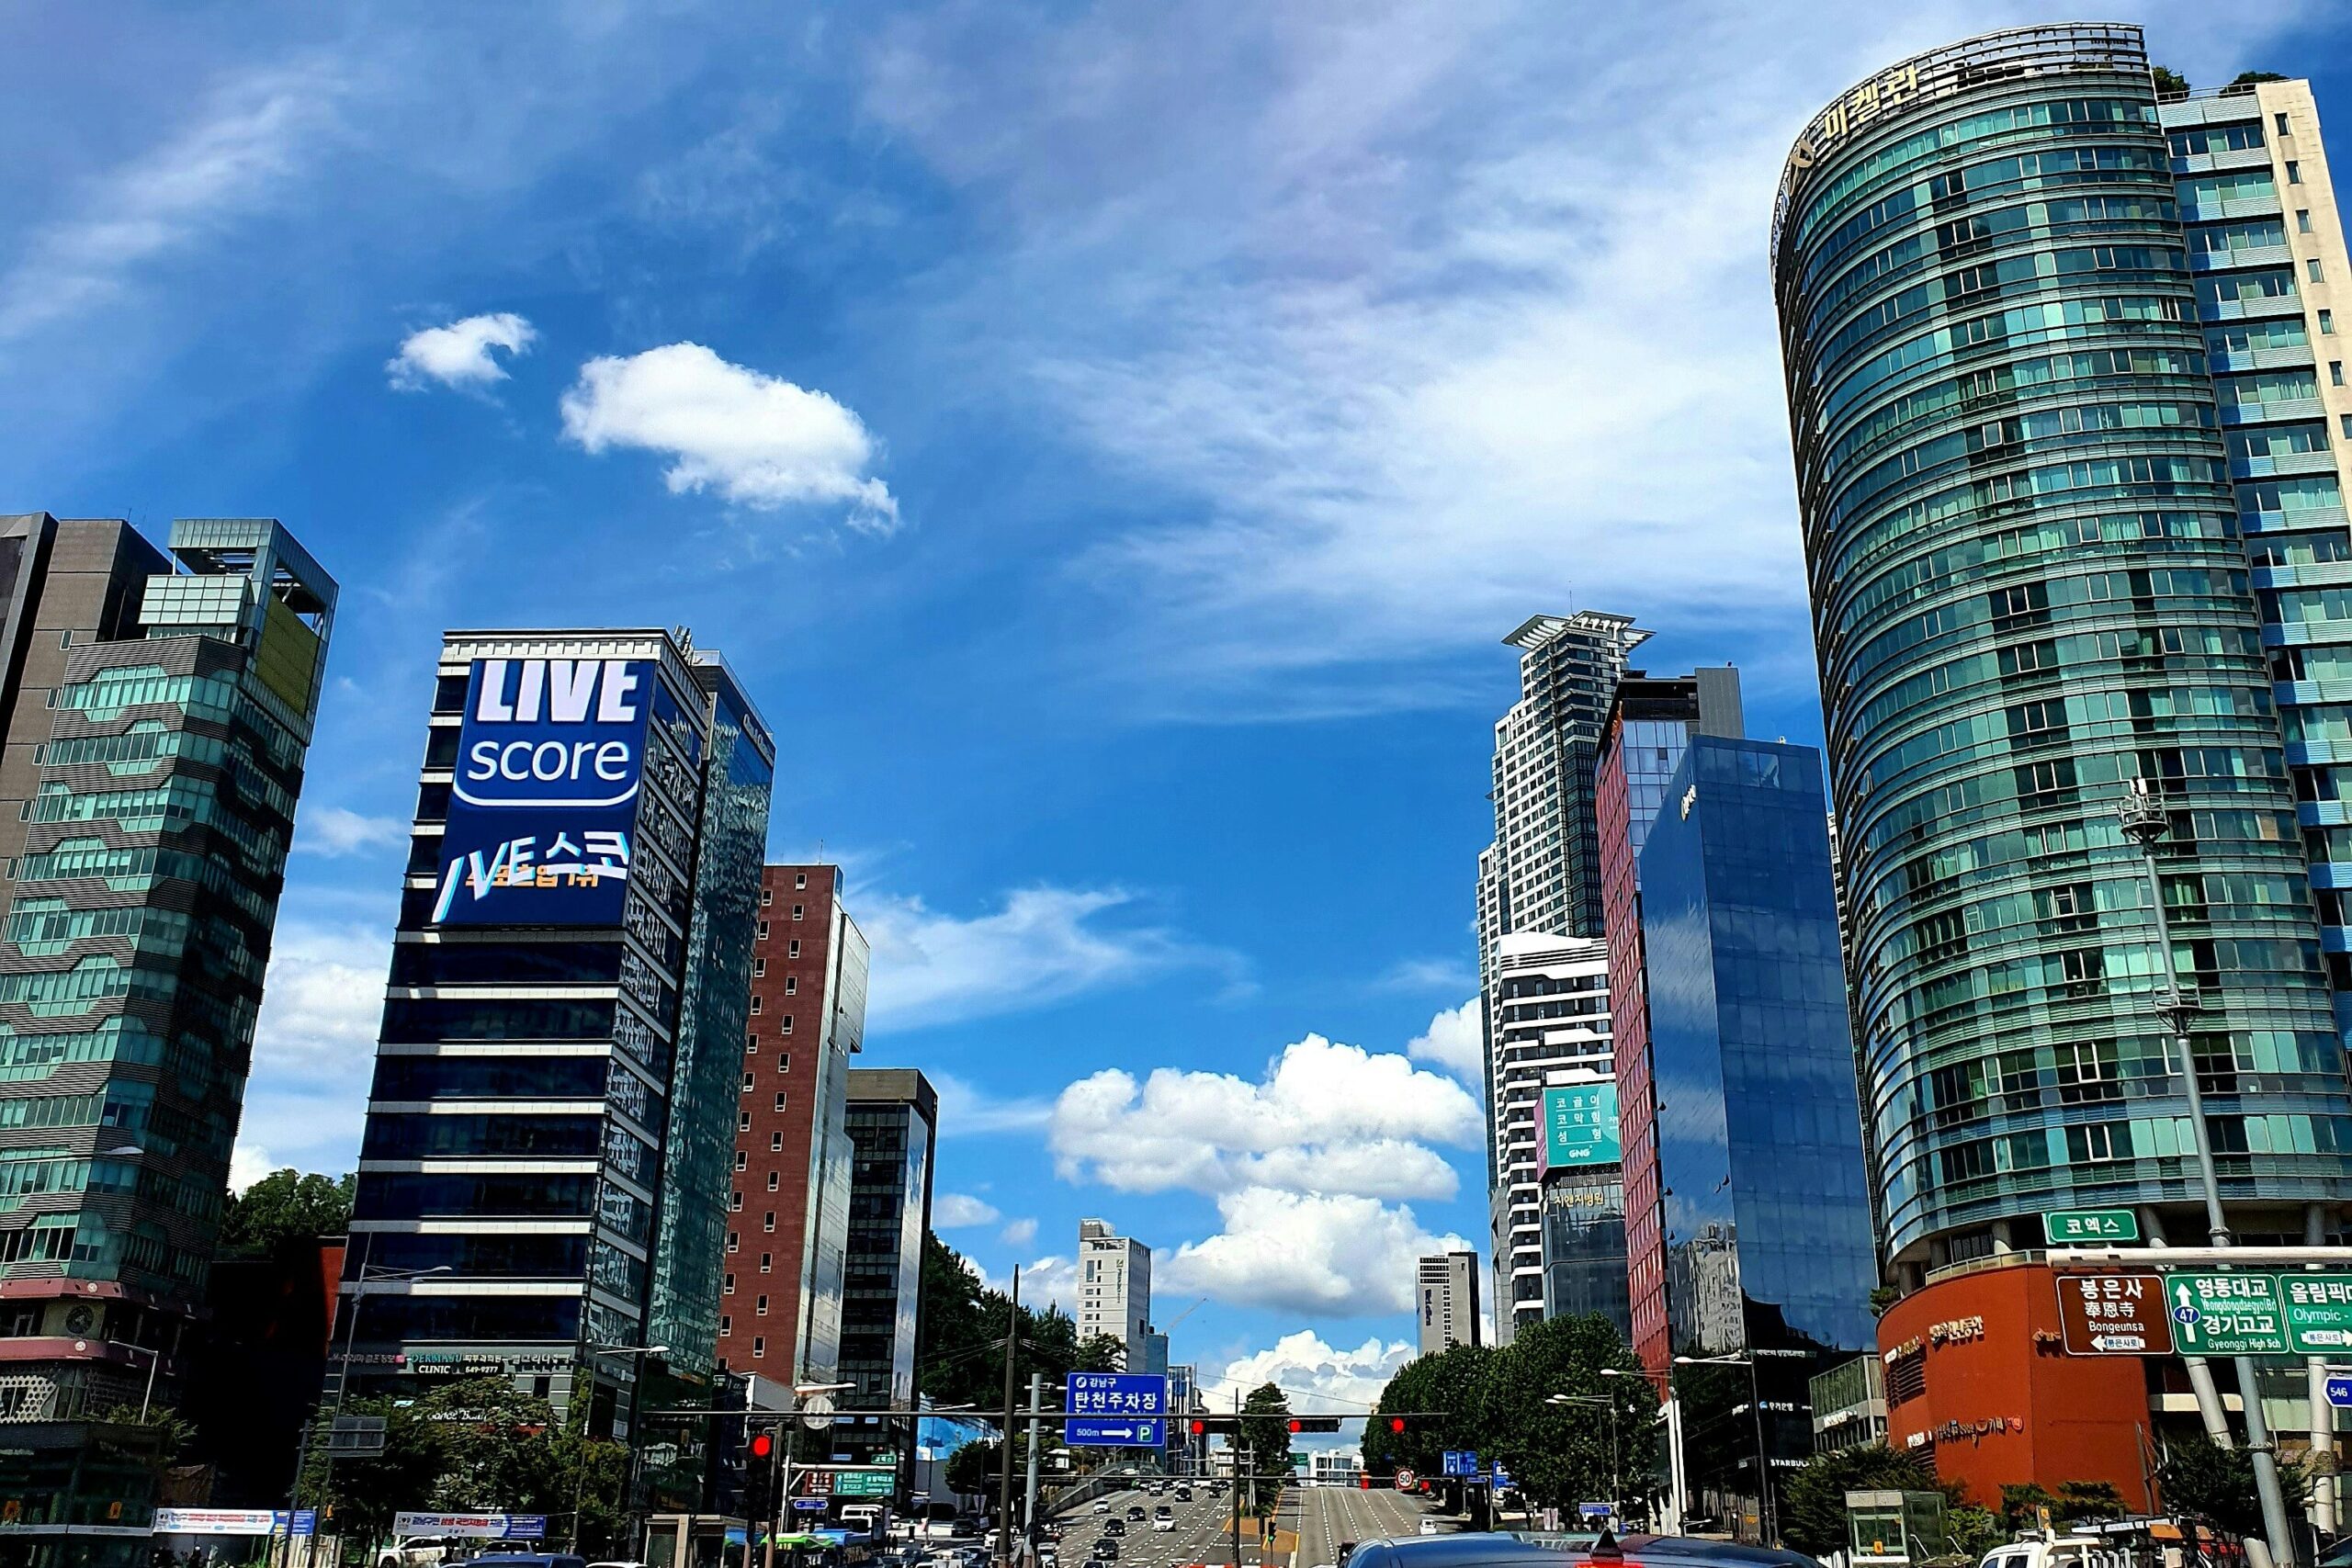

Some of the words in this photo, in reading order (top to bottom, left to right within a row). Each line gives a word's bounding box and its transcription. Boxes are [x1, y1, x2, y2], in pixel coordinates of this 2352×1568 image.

[1824, 62, 1919, 139] 미켈란
[476, 660, 641, 723] LIVE
[467, 740, 630, 782] score
[1568, 1148, 1590, 1158] GNG
[2066, 1216, 2120, 1235] 코엑스
[2079, 1278, 2143, 1300] 봉은사
[2195, 1277, 2270, 1299] 영동대교
[2084, 1302, 2135, 1318] 奉恩寺
[2179, 1309, 2194, 1322] 47
[2293, 1308, 2342, 1324] Olympic
[2088, 1321, 2145, 1334] Bongeunsa
[2201, 1314, 2277, 1336] 경기고교
[2107, 1337, 2139, 1348] 봉은사로
[2208, 1338, 2247, 1351] Gyeonggi
[2248, 1337, 2267, 1351] High
[2267, 1337, 2282, 1348] Sch
[418, 1365, 450, 1374] CLINIC
[1089, 1377, 1117, 1388] 강남구
[2330, 1387, 2348, 1397] 546
[1074, 1391, 1158, 1410] 탄천주차장
[1076, 1428, 1100, 1437] 500m
[1399, 1473, 1410, 1483] 50
